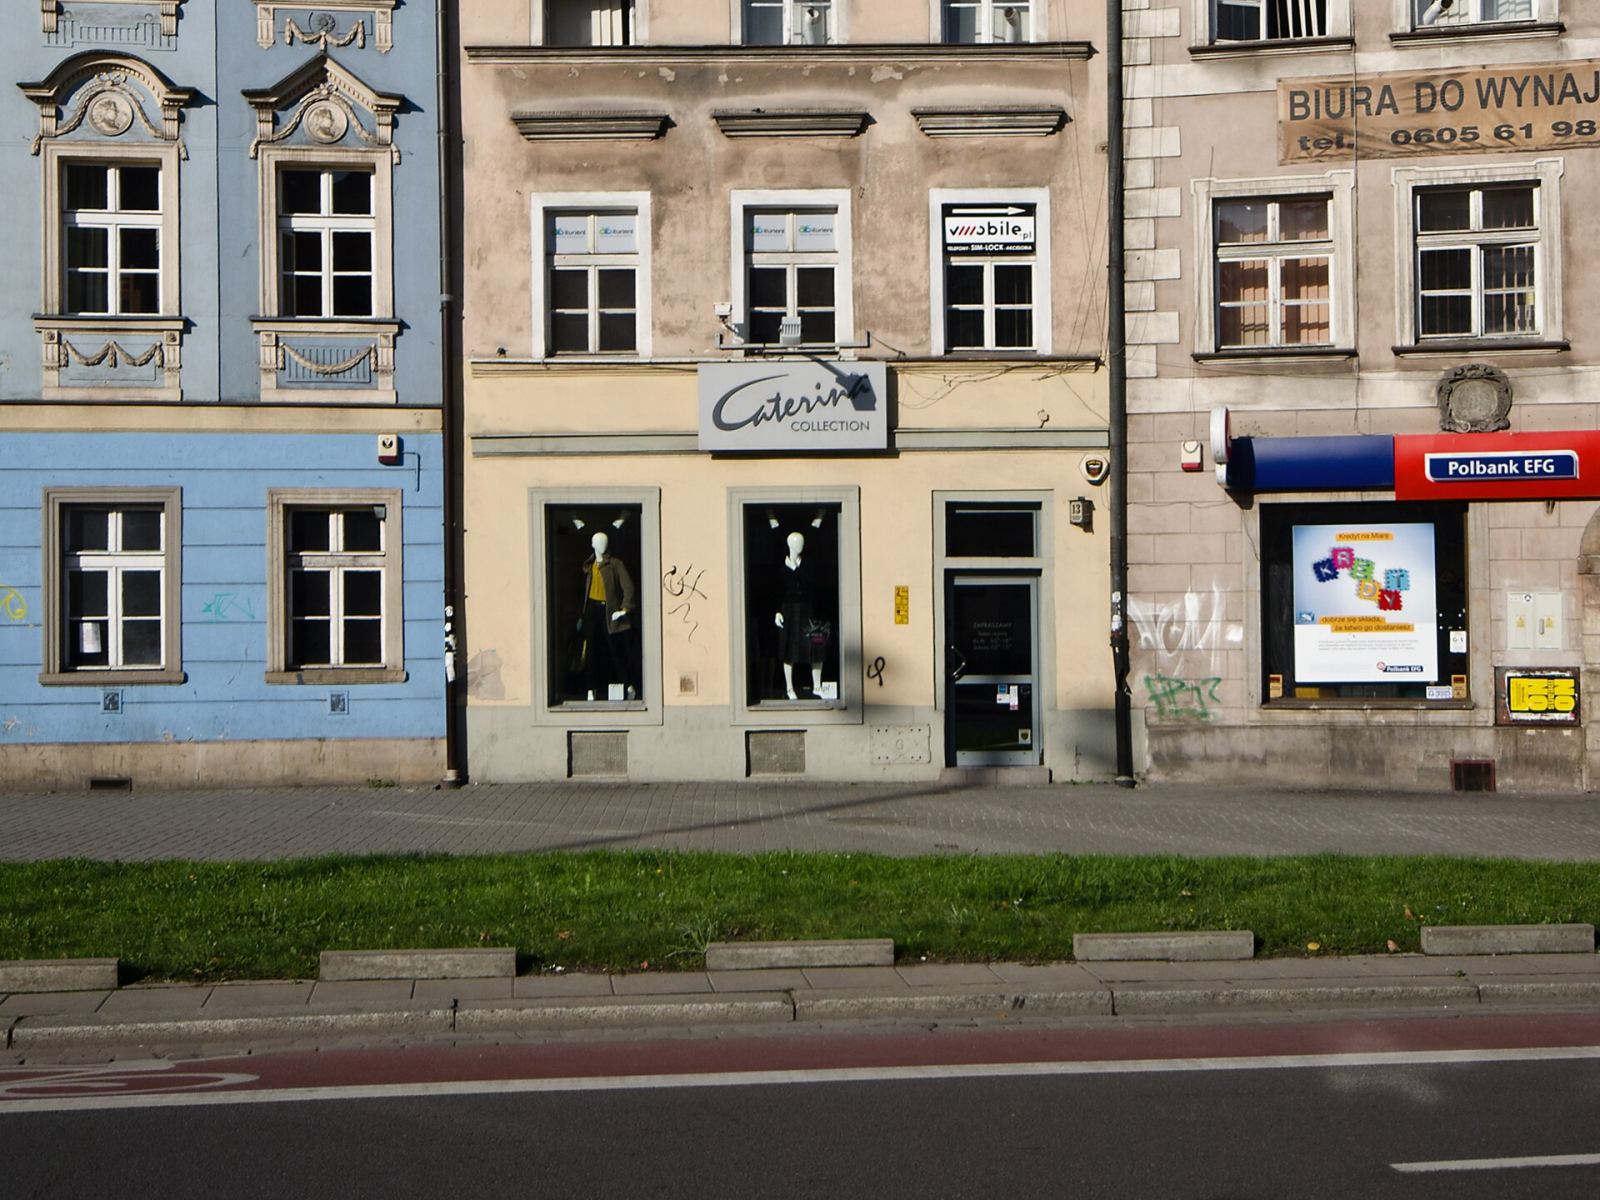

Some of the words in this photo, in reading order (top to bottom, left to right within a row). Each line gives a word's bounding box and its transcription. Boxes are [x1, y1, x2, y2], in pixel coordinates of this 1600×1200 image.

[1289, 84, 1399, 121] BIURA
[1415, 79, 1464, 114] DO
[1475, 70, 1600, 109] WYNAJ
[1297, 133, 1355, 151] tel.
[1390, 126, 1480, 146] 0605
[1493, 123, 1533, 140] 61
[1551, 120, 1598, 138] 98
[712, 373, 870, 431] Caterina
[790, 420, 870, 432] COLLECTION
[1448, 459, 1519, 476] Polbank
[1524, 459, 1555, 474] EFG
[1072, 503, 1081, 515] 13
